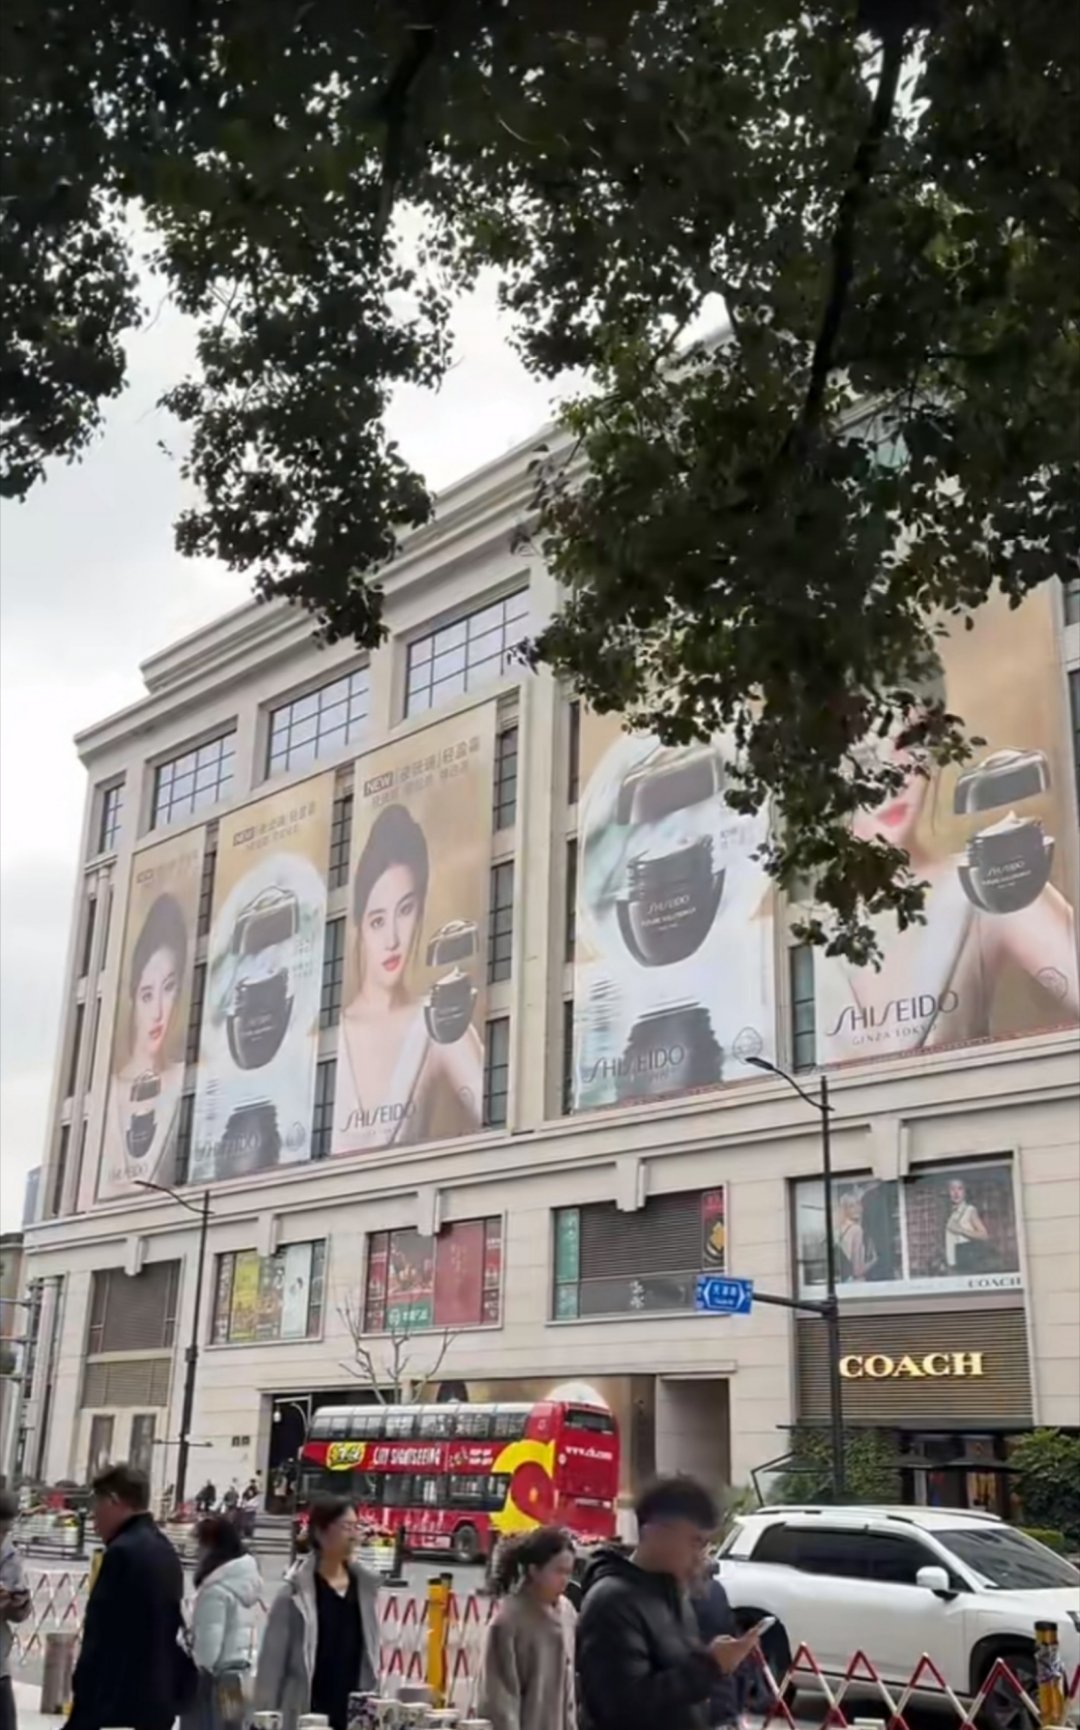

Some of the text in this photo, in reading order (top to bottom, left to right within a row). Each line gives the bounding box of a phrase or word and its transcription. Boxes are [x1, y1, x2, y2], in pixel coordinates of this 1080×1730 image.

[364, 770, 394, 797] NEW
[825, 990, 959, 1037] SHISEIDO
[581, 1045, 685, 1084] SHISEIDO
[340, 1102, 417, 1133] SHISEIDO
[967, 1277, 1021, 1289] COACH
[839, 1352, 984, 1378] COACH
